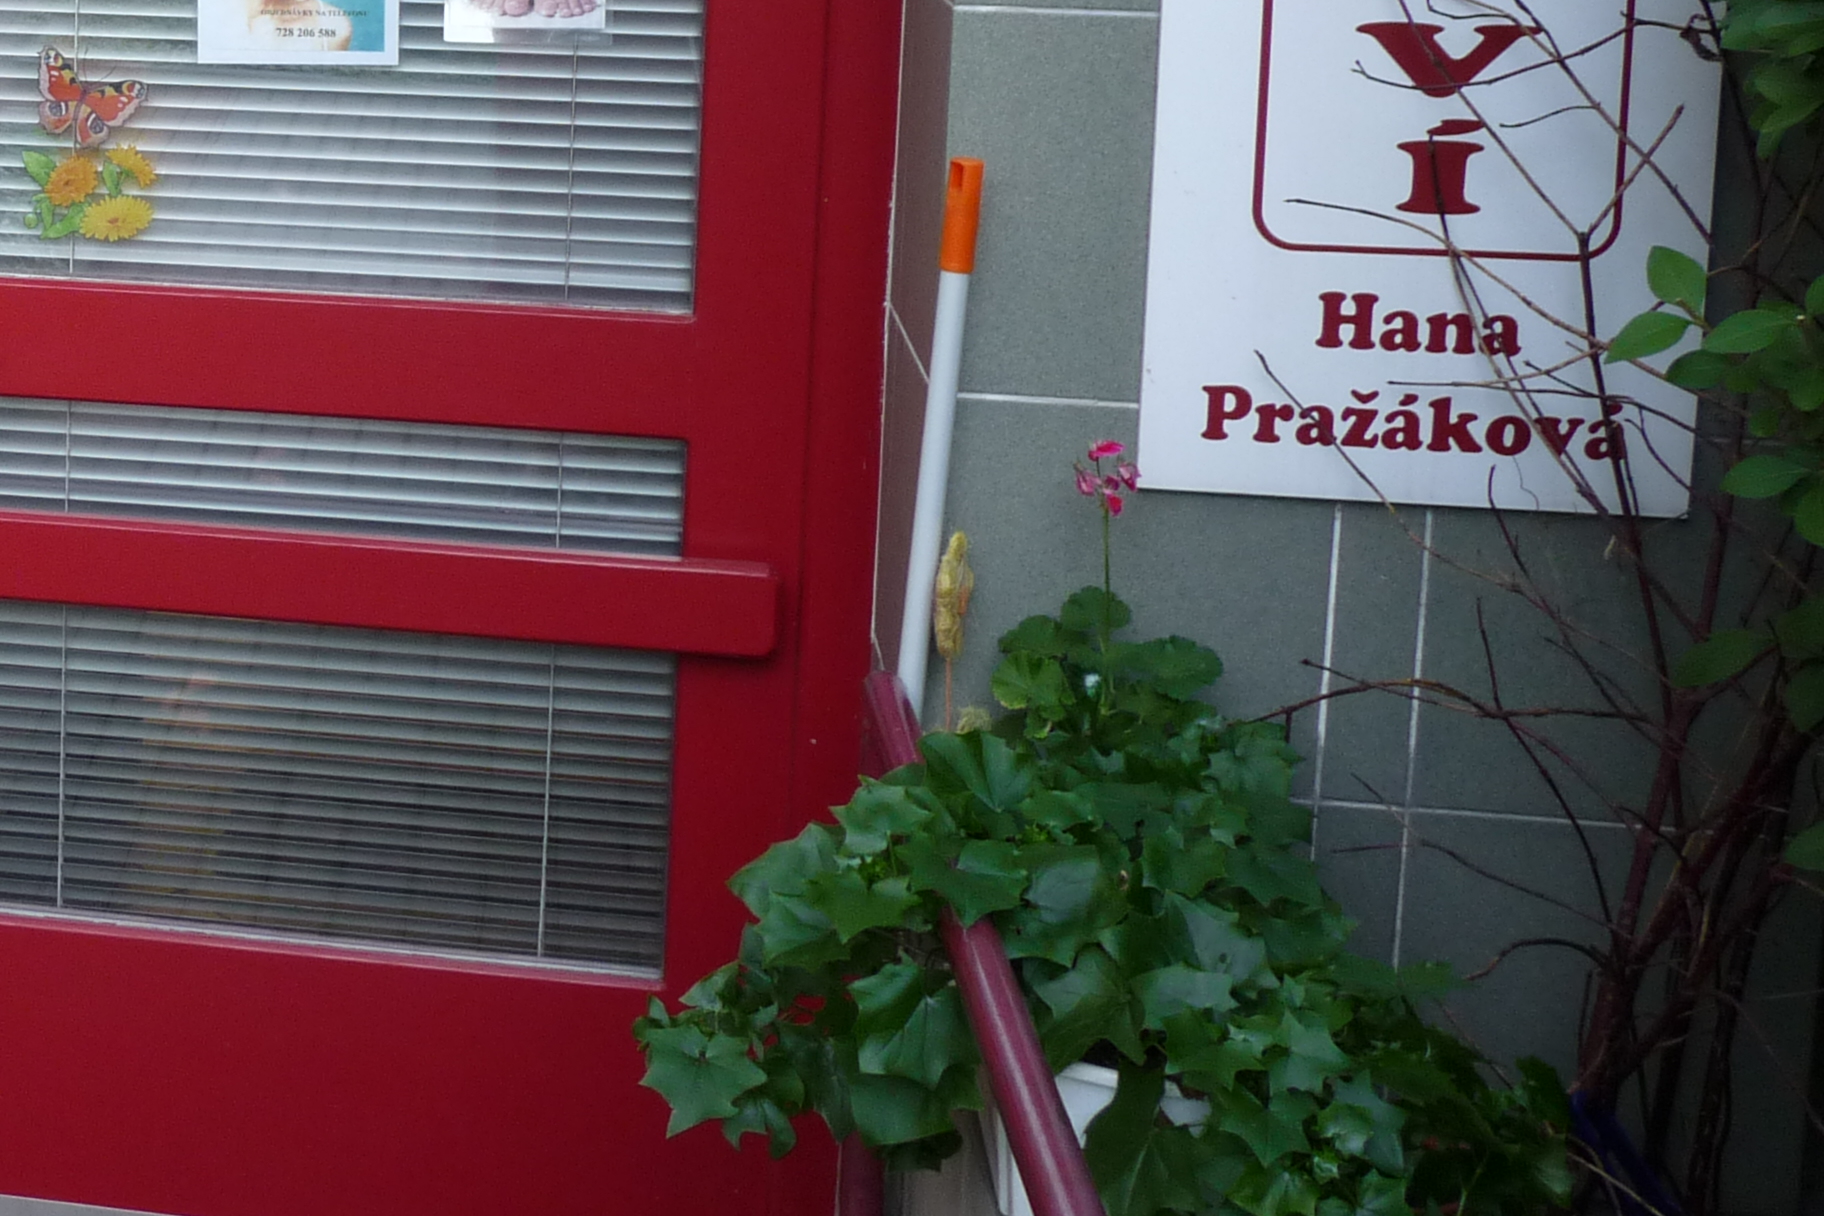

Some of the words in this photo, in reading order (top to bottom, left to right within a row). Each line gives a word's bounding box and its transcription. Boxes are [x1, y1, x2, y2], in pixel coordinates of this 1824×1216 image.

[276, 27, 295, 38] 728
[297, 27, 316, 38] 206
[317, 27, 337, 38] 588
[1315, 290, 1523, 358] Hana
[1200, 384, 1628, 462] Pražáková
